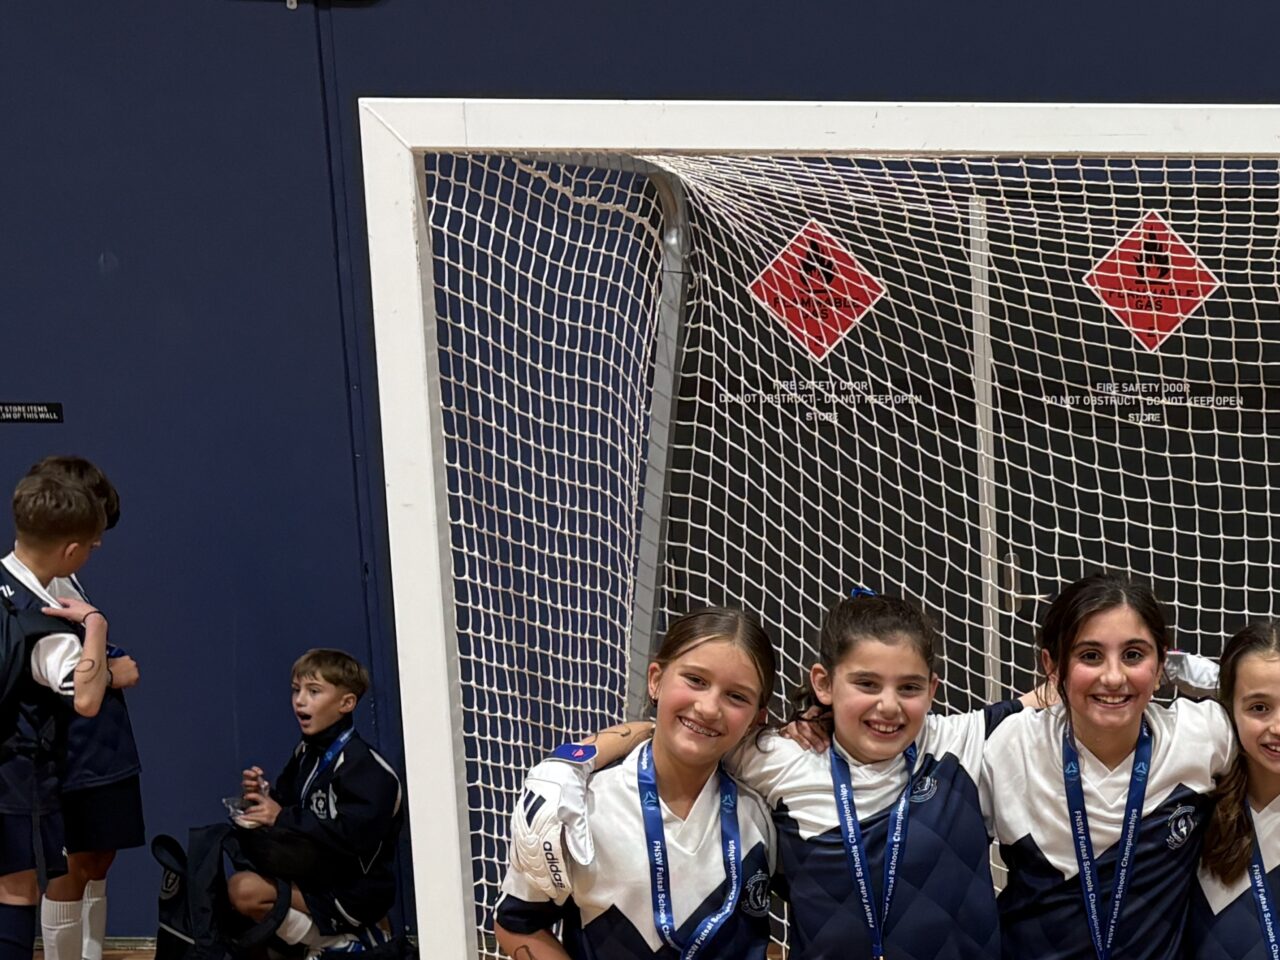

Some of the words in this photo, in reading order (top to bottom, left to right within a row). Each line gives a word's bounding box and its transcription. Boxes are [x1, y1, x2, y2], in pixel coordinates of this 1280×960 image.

[1135, 300, 1163, 311] GAS
[798, 381, 836, 391] SAFETY
[840, 381, 868, 391] DOOR
[1096, 383, 1119, 392] FIRE
[1121, 383, 1160, 392] SAFETY
[1163, 383, 1190, 393] DOOR
[841, 395, 862, 404] NOT
[1060, 396, 1080, 405] NOT
[1083, 396, 1136, 405] OBSTRUCT
[1187, 397, 1213, 405] KEEP
[1216, 397, 1243, 406] OPEN
[806, 412, 838, 421] STORE
[1128, 413, 1161, 422] STORE
[840, 783, 857, 844] Championships
[1074, 810, 1085, 834] FNSW
[653, 840, 664, 866] FNSW
[888, 844, 899, 875] Schools
[1078, 835, 1088, 860] Futsal
[1115, 868, 1126, 899] Schools
[1121, 808, 1138, 867] Championships
[543, 841, 565, 888] adidas
[850, 845, 863, 878] Schools
[656, 867, 665, 892] Futsal
[1083, 861, 1093, 892] Schools
[857, 879, 869, 904] Futsal
[1252, 864, 1264, 888] FNSW
[1258, 888, 1269, 912] Futsal
[1264, 912, 1275, 943] Schools
